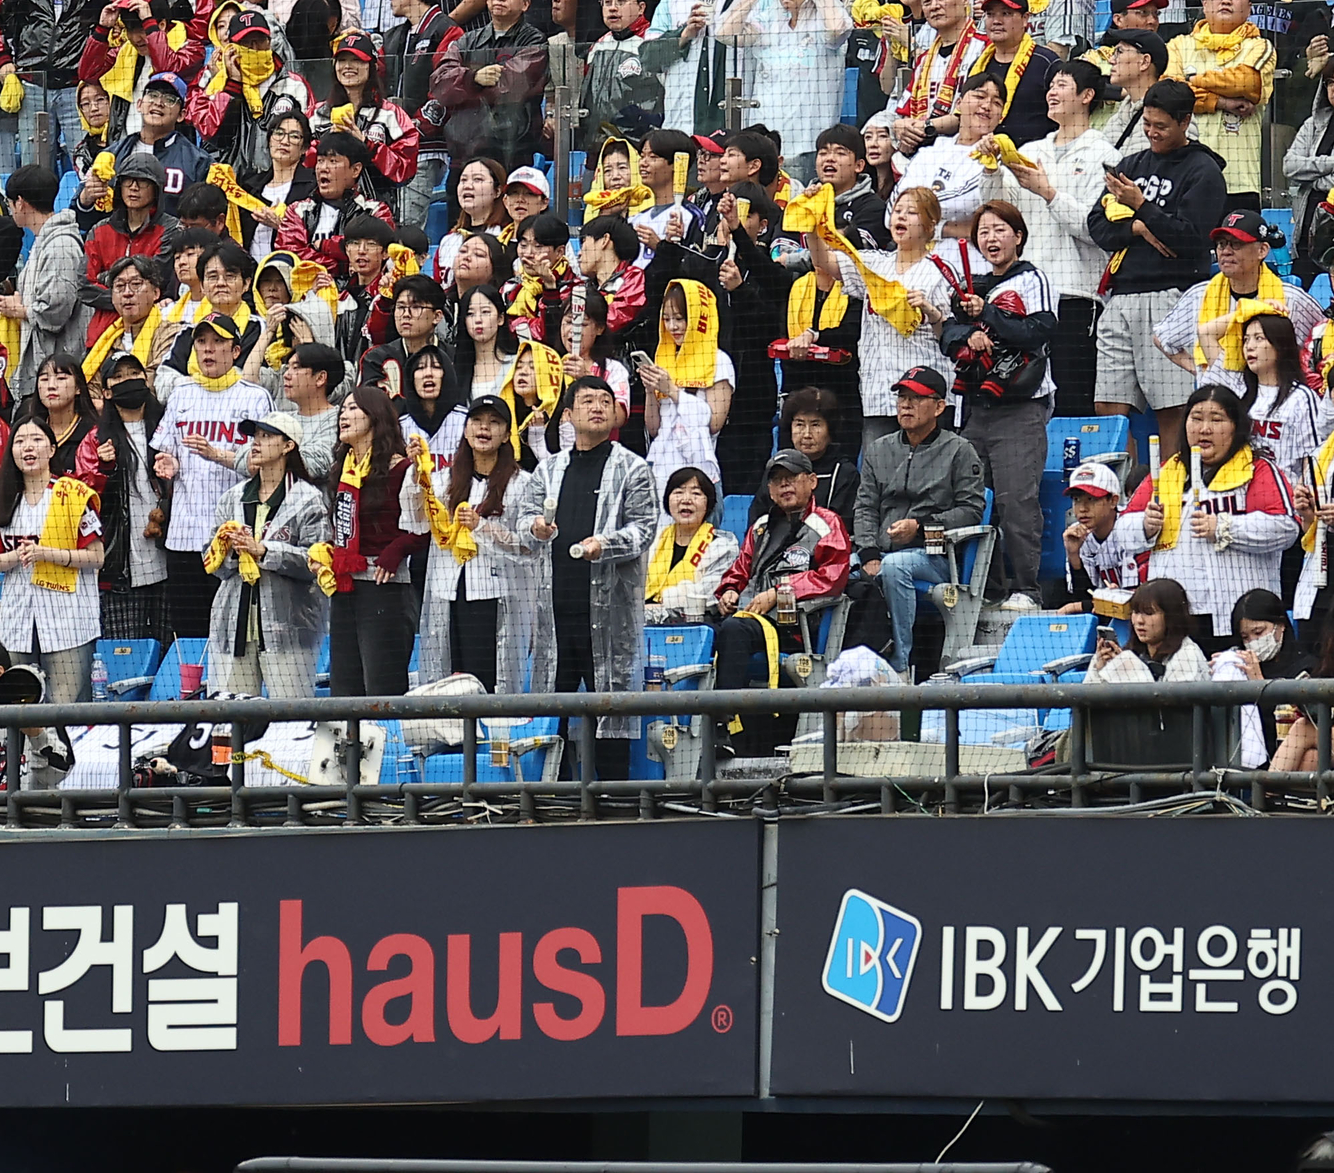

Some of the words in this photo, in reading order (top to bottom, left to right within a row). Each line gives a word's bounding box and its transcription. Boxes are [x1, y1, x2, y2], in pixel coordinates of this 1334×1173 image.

[232, 409, 250, 420] LG
[176, 420, 249, 445] TWINS
[939, 925, 1302, 1017] IBK기업은행
